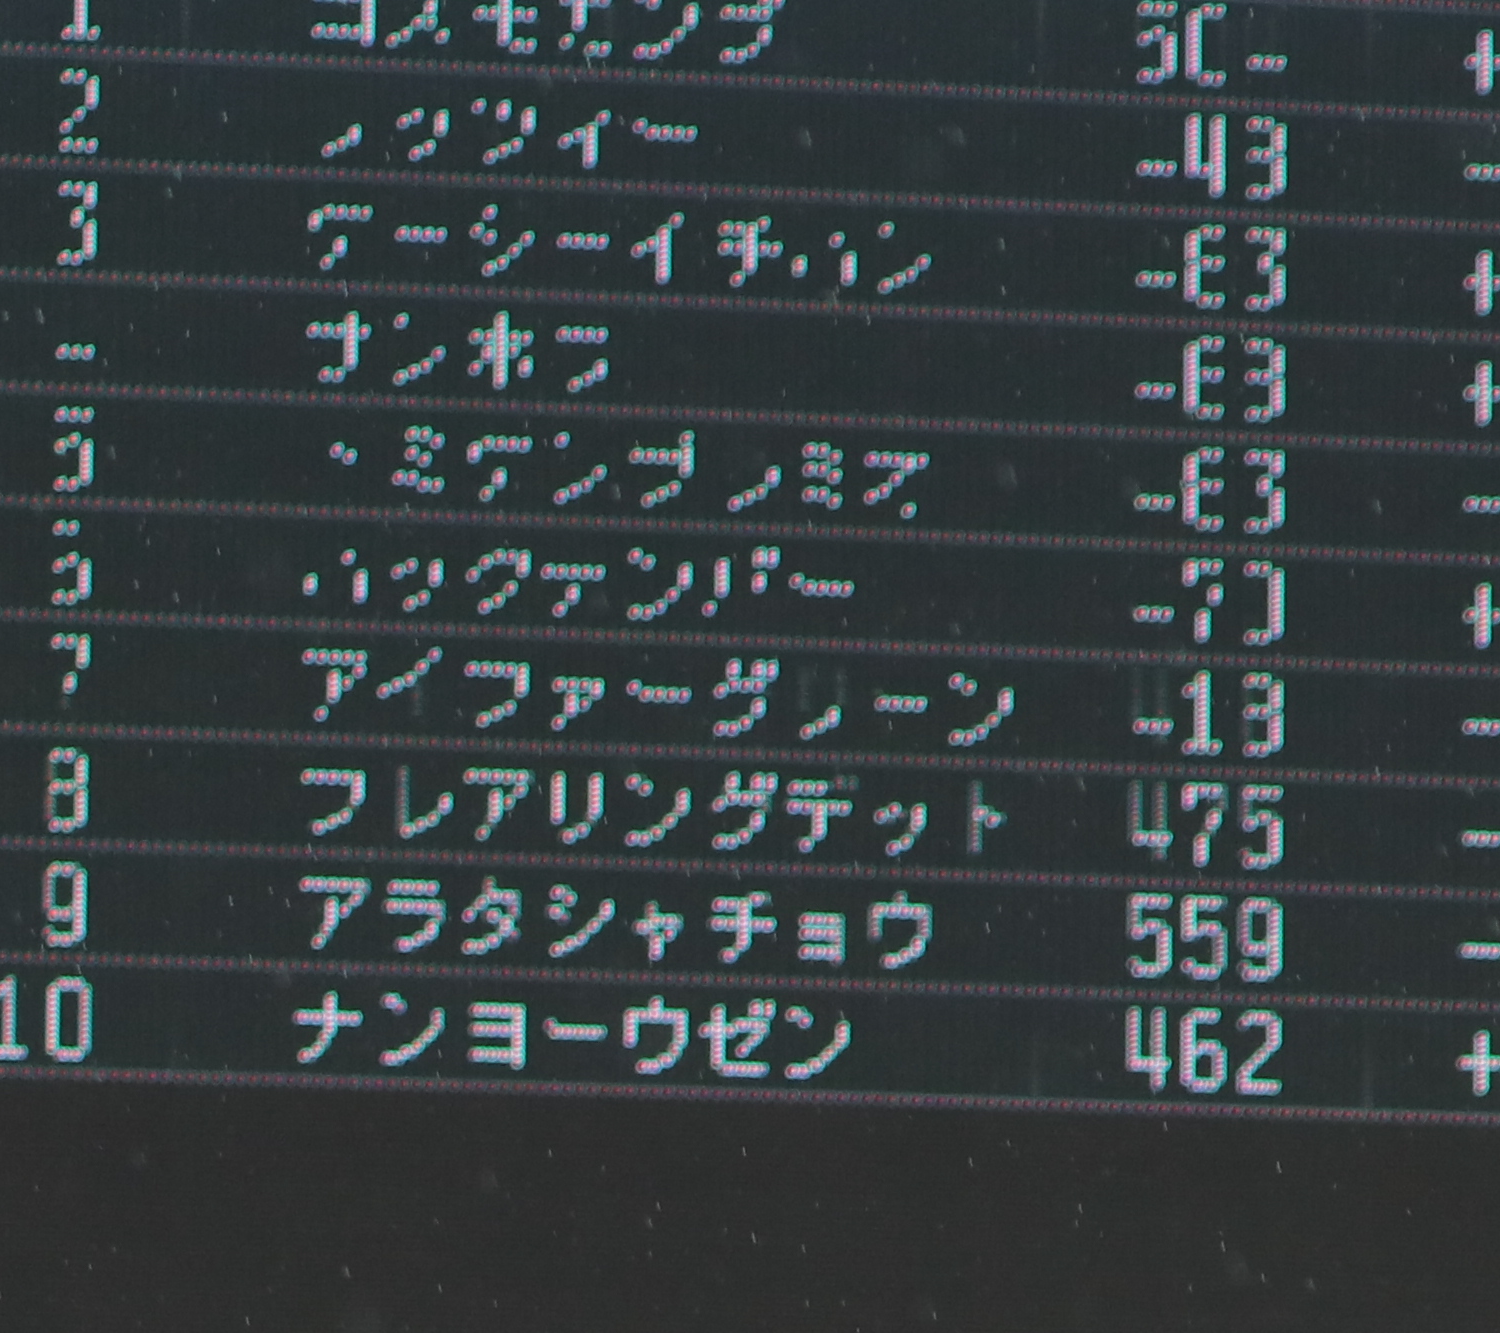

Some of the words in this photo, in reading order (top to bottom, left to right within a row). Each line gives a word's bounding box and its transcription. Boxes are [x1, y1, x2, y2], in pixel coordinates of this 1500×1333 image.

[58, 67, 101, 154] 2
[57, 179, 99, 266] 3
[50, 632, 92, 704] 7
[46, 746, 90, 834] 8
[1131, 782, 1285, 870] 475
[42, 860, 88, 948] 9
[299, 875, 933, 970] アラタシャチョウ
[1130, 892, 1284, 983] 559
[293, 990, 851, 1080] ナンヨーウゼン
[1125, 1006, 1283, 1096] 462
